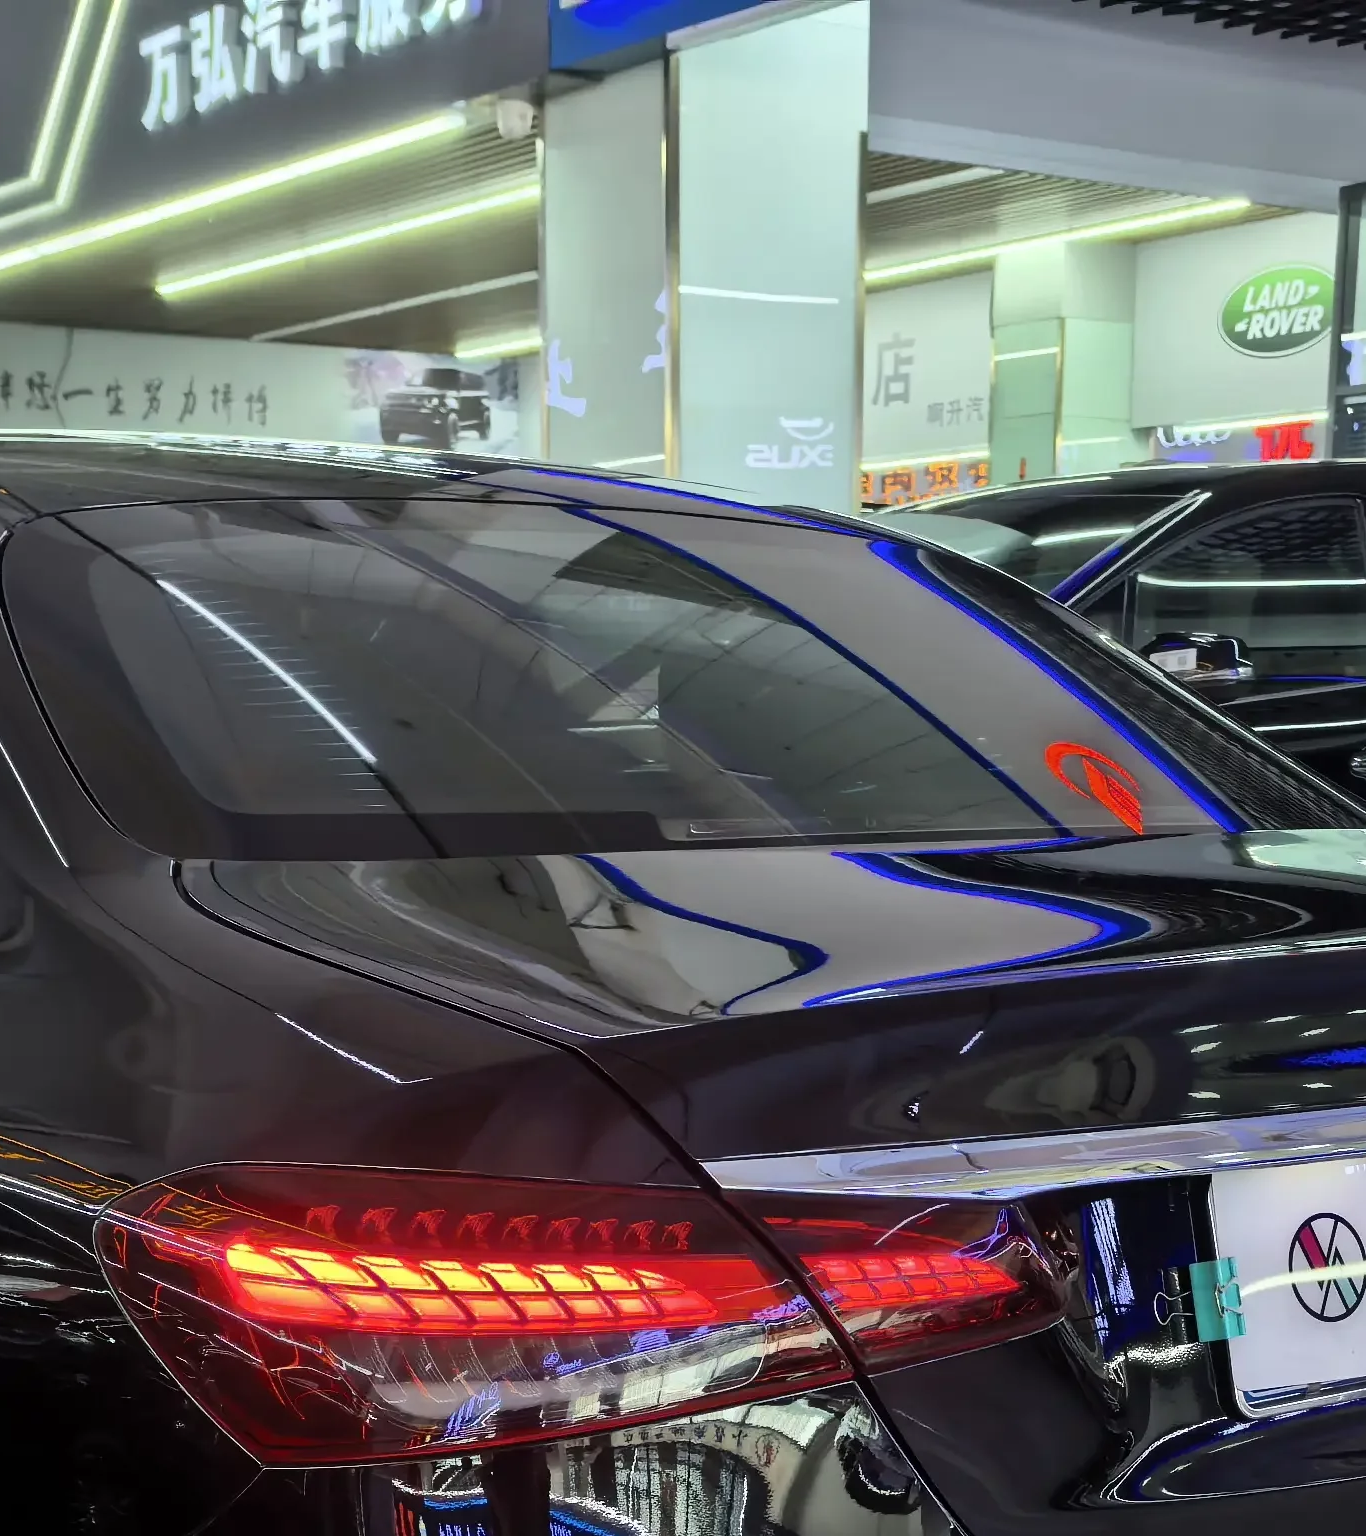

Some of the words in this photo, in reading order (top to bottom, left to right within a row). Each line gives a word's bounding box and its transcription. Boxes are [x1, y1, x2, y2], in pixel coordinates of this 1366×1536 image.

[1243, 278, 1305, 313] LAND
[1247, 304, 1325, 340] ROVER
[872, 332, 916, 407] 店
